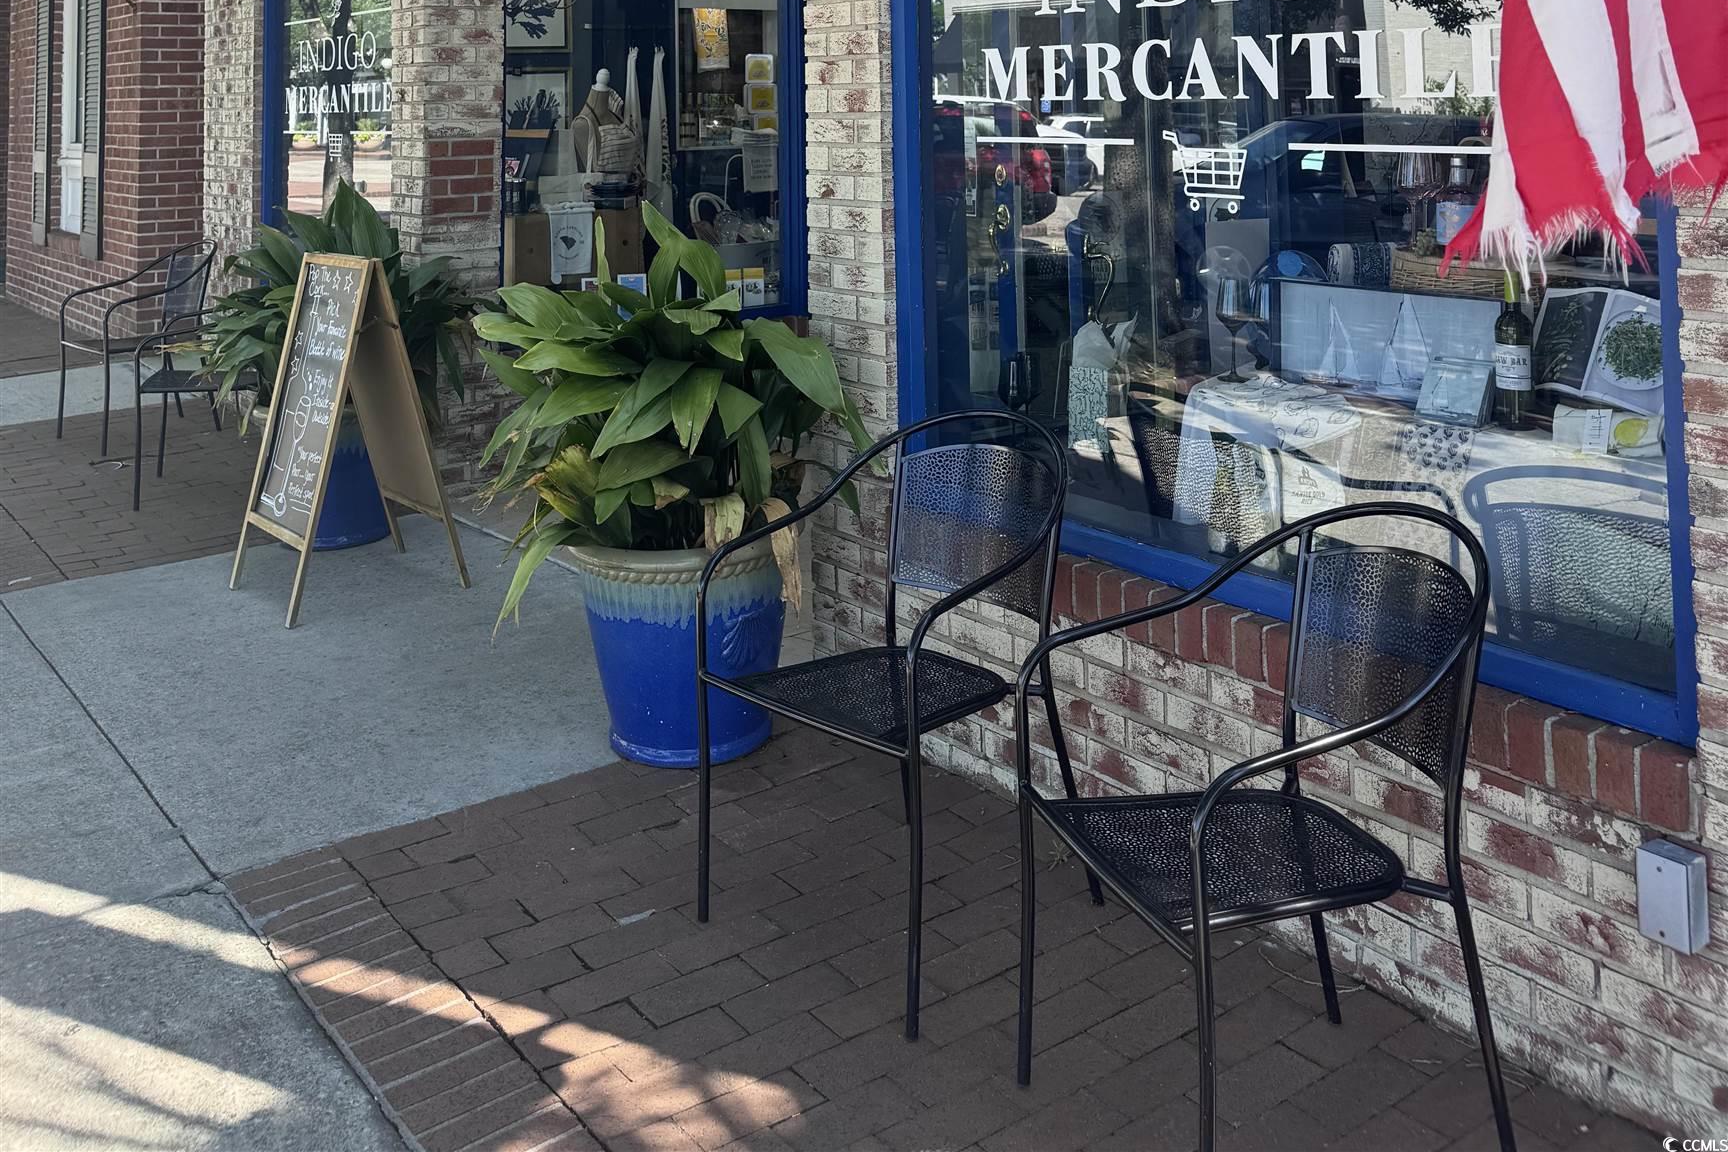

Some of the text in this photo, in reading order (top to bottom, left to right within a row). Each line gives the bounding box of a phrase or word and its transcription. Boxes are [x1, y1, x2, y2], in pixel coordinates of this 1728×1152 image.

[298, 30, 377, 73] INDIGO
[285, 82, 393, 114] MERCANTILE
[309, 263, 332, 283] Pop The
[1510, 357, 1528, 366] BAR
